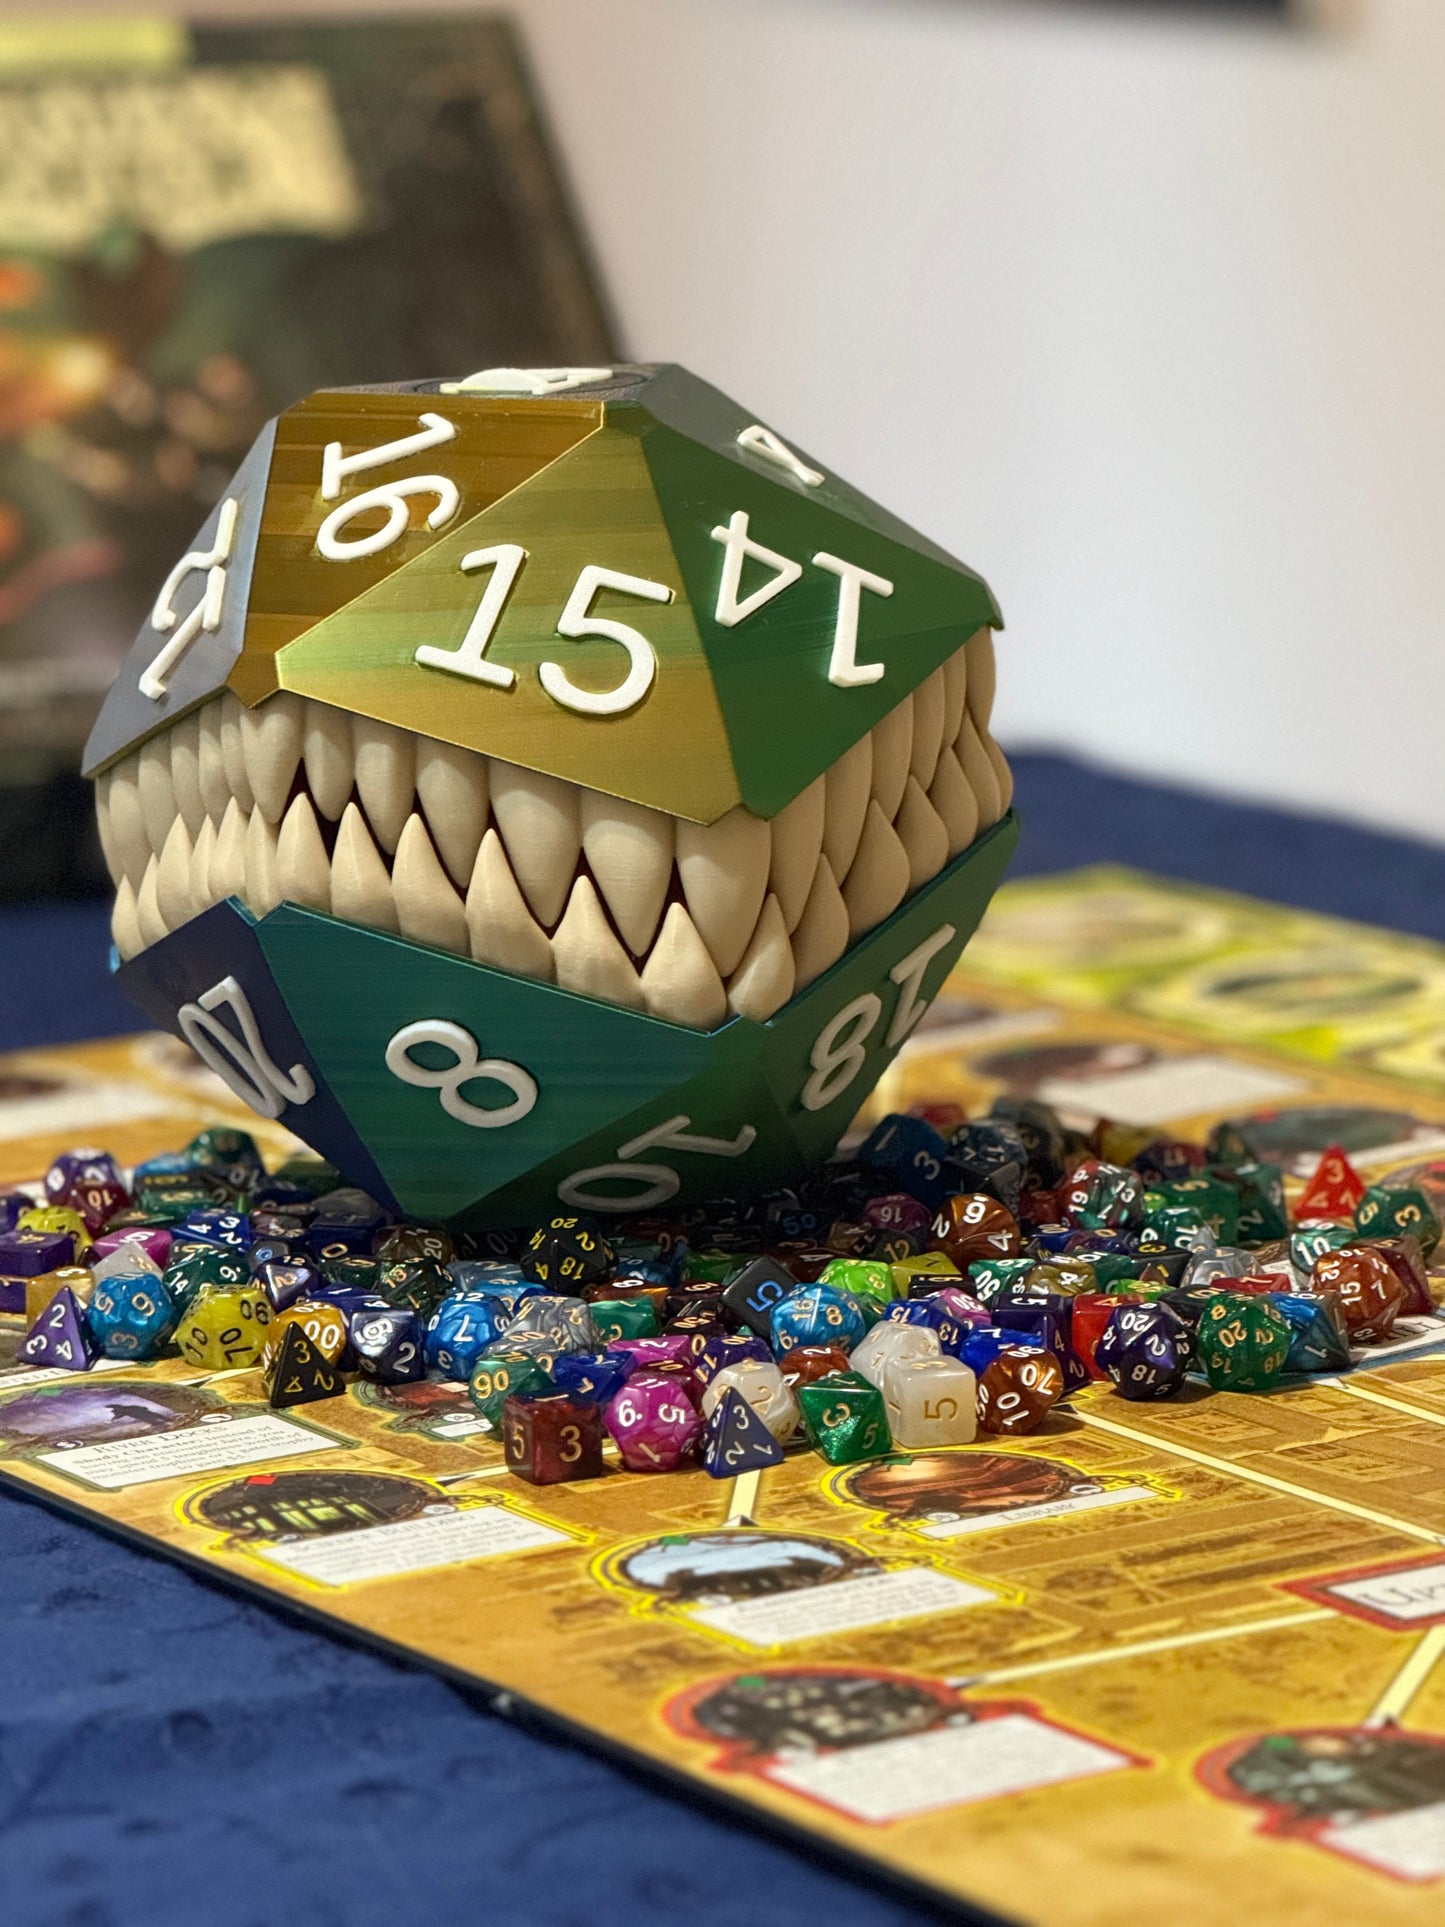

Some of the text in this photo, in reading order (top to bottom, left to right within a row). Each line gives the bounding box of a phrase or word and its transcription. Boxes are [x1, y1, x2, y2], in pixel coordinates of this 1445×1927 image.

[314, 414, 460, 563] 16
[710, 510, 894, 689] 14
[414, 543, 673, 715] 15
[801, 923, 957, 1111] 18
[384, 1018, 538, 1128] 8
[557, 1114, 757, 1213] 10
[914, 1150, 941, 1181] 3
[1325, 1159, 1346, 1184] 3
[1068, 1190, 1089, 1213] 19
[1112, 1180, 1135, 1204] 13
[219, 1216, 240, 1229] 3
[551, 1217, 578, 1229] 20
[1359, 1201, 1379, 1225] 5
[1394, 1204, 1422, 1228] 3
[187, 1224, 212, 1234] 4
[931, 1213, 950, 1239] 2
[219, 1232, 242, 1245] 2
[575, 1231, 596, 1252] 2
[987, 1229, 1013, 1252] 4
[535, 1261, 549, 1281] 4
[559, 1257, 585, 1280] 18
[1320, 1260, 1340, 1282] 12
[170, 1272, 189, 1295] 14
[1340, 1281, 1361, 1306] 15
[1370, 1279, 1386, 1300] 7
[95, 1294, 115, 1316] 5
[454, 1292, 484, 1301] 12
[746, 1280, 783, 1312] 5
[50, 1303, 66, 1328] 2
[792, 1299, 814, 1322] 16
[826, 1305, 843, 1326] 8
[888, 1306, 911, 1324] 15
[1121, 1312, 1150, 1331] 20
[1210, 1304, 1226, 1320] 8
[305, 1320, 339, 1349] 00
[453, 1314, 474, 1342] 7
[939, 1323, 958, 1345] 13
[1218, 1319, 1248, 1348] 20
[1255, 1329, 1274, 1344] 2
[26, 1335, 47, 1354] 3
[56, 1340, 73, 1360] 4
[111, 1332, 138, 1349] 3
[185, 1327, 208, 1359] 10
[220, 1328, 253, 1363] 70
[294, 1340, 311, 1363] 3
[1145, 1334, 1166, 1356] 2
[1174, 1331, 1190, 1355] 12
[392, 1341, 416, 1374] 2
[438, 1349, 453, 1370] 3
[1068, 1359, 1085, 1378] 2
[284, 1376, 303, 1393] 4
[314, 1369, 334, 1390] 2
[473, 1368, 510, 1399] 90
[1021, 1363, 1056, 1396] 70
[1131, 1364, 1157, 1384] 18
[659, 1403, 685, 1424] 5
[732, 1405, 749, 1430] 3
[822, 1402, 850, 1428] 3
[924, 1397, 958, 1422] 5
[996, 1391, 1030, 1426] 10
[158, 1426, 227, 1441] DOCKS
[512, 1420, 525, 1460] 5
[559, 1425, 582, 1462] 3
[862, 1422, 879, 1449] 5
[725, 1441, 745, 1465] 2
[1001, 1502, 1075, 1521] LIBRARY
